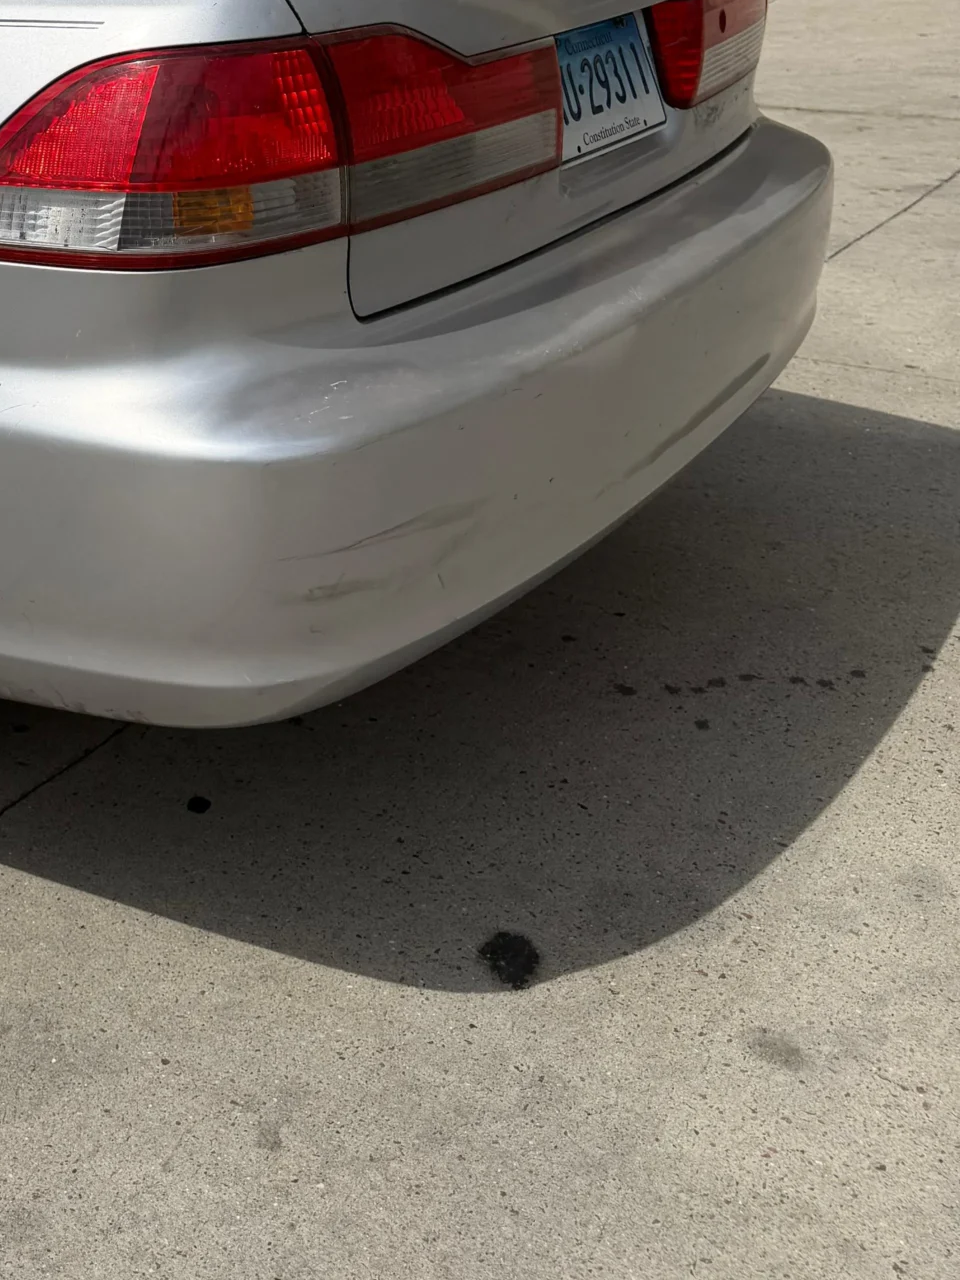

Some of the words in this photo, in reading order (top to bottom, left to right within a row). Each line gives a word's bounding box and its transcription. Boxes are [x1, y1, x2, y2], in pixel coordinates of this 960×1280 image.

[564, 30, 614, 56] Connecticut
[560, 41, 650, 126] U·29311
[582, 120, 626, 146] Constitution
[623, 116, 641, 131] State
